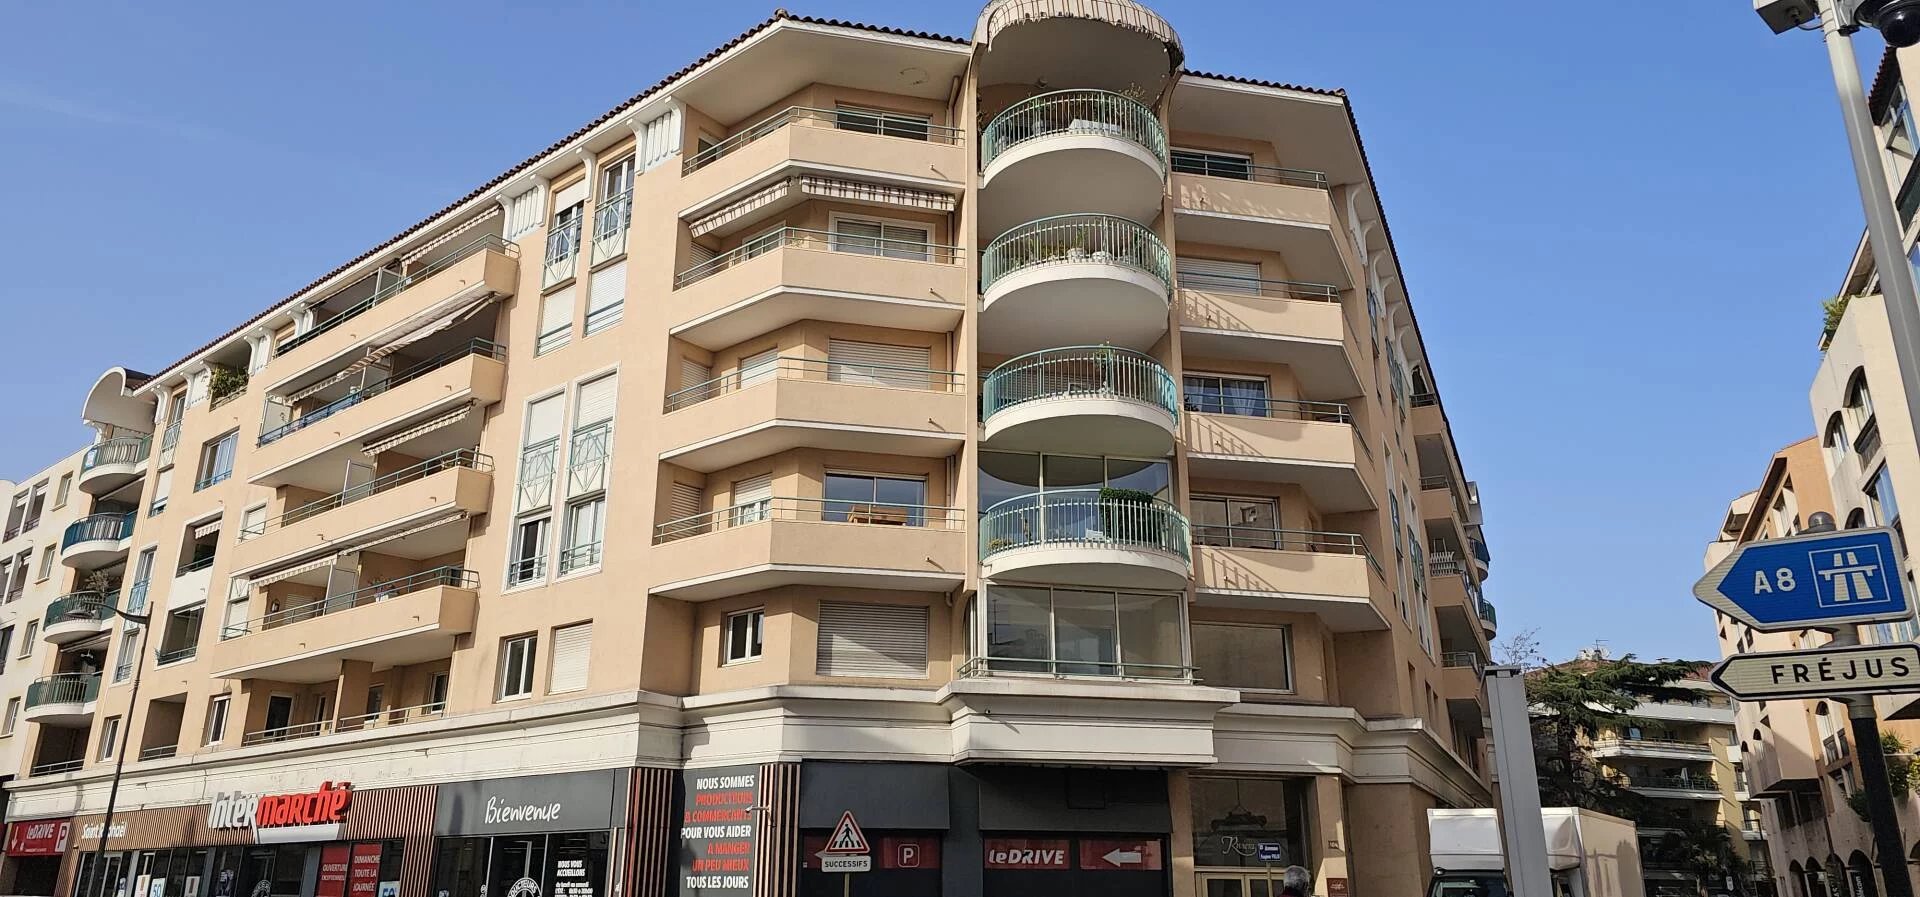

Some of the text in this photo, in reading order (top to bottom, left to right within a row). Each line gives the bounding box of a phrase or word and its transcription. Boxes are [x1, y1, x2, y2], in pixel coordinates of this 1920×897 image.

[1754, 567, 1796, 595] A8
[1770, 656, 1910, 685] FRÉJUS
[696, 775, 755, 790] NOUS SOMMES
[207, 780, 351, 843] Intermarché
[485, 796, 561, 824] Bienvenue
[681, 825, 752, 839] POUR VOUS AIDER
[354, 854, 381, 864] DIMANCHE
[903, 847, 914, 864] P
[988, 849, 1065, 865] leDRIVE
[354, 868, 377, 878] TOUTE LA
[686, 876, 749, 889] TOUS LES JOURS
